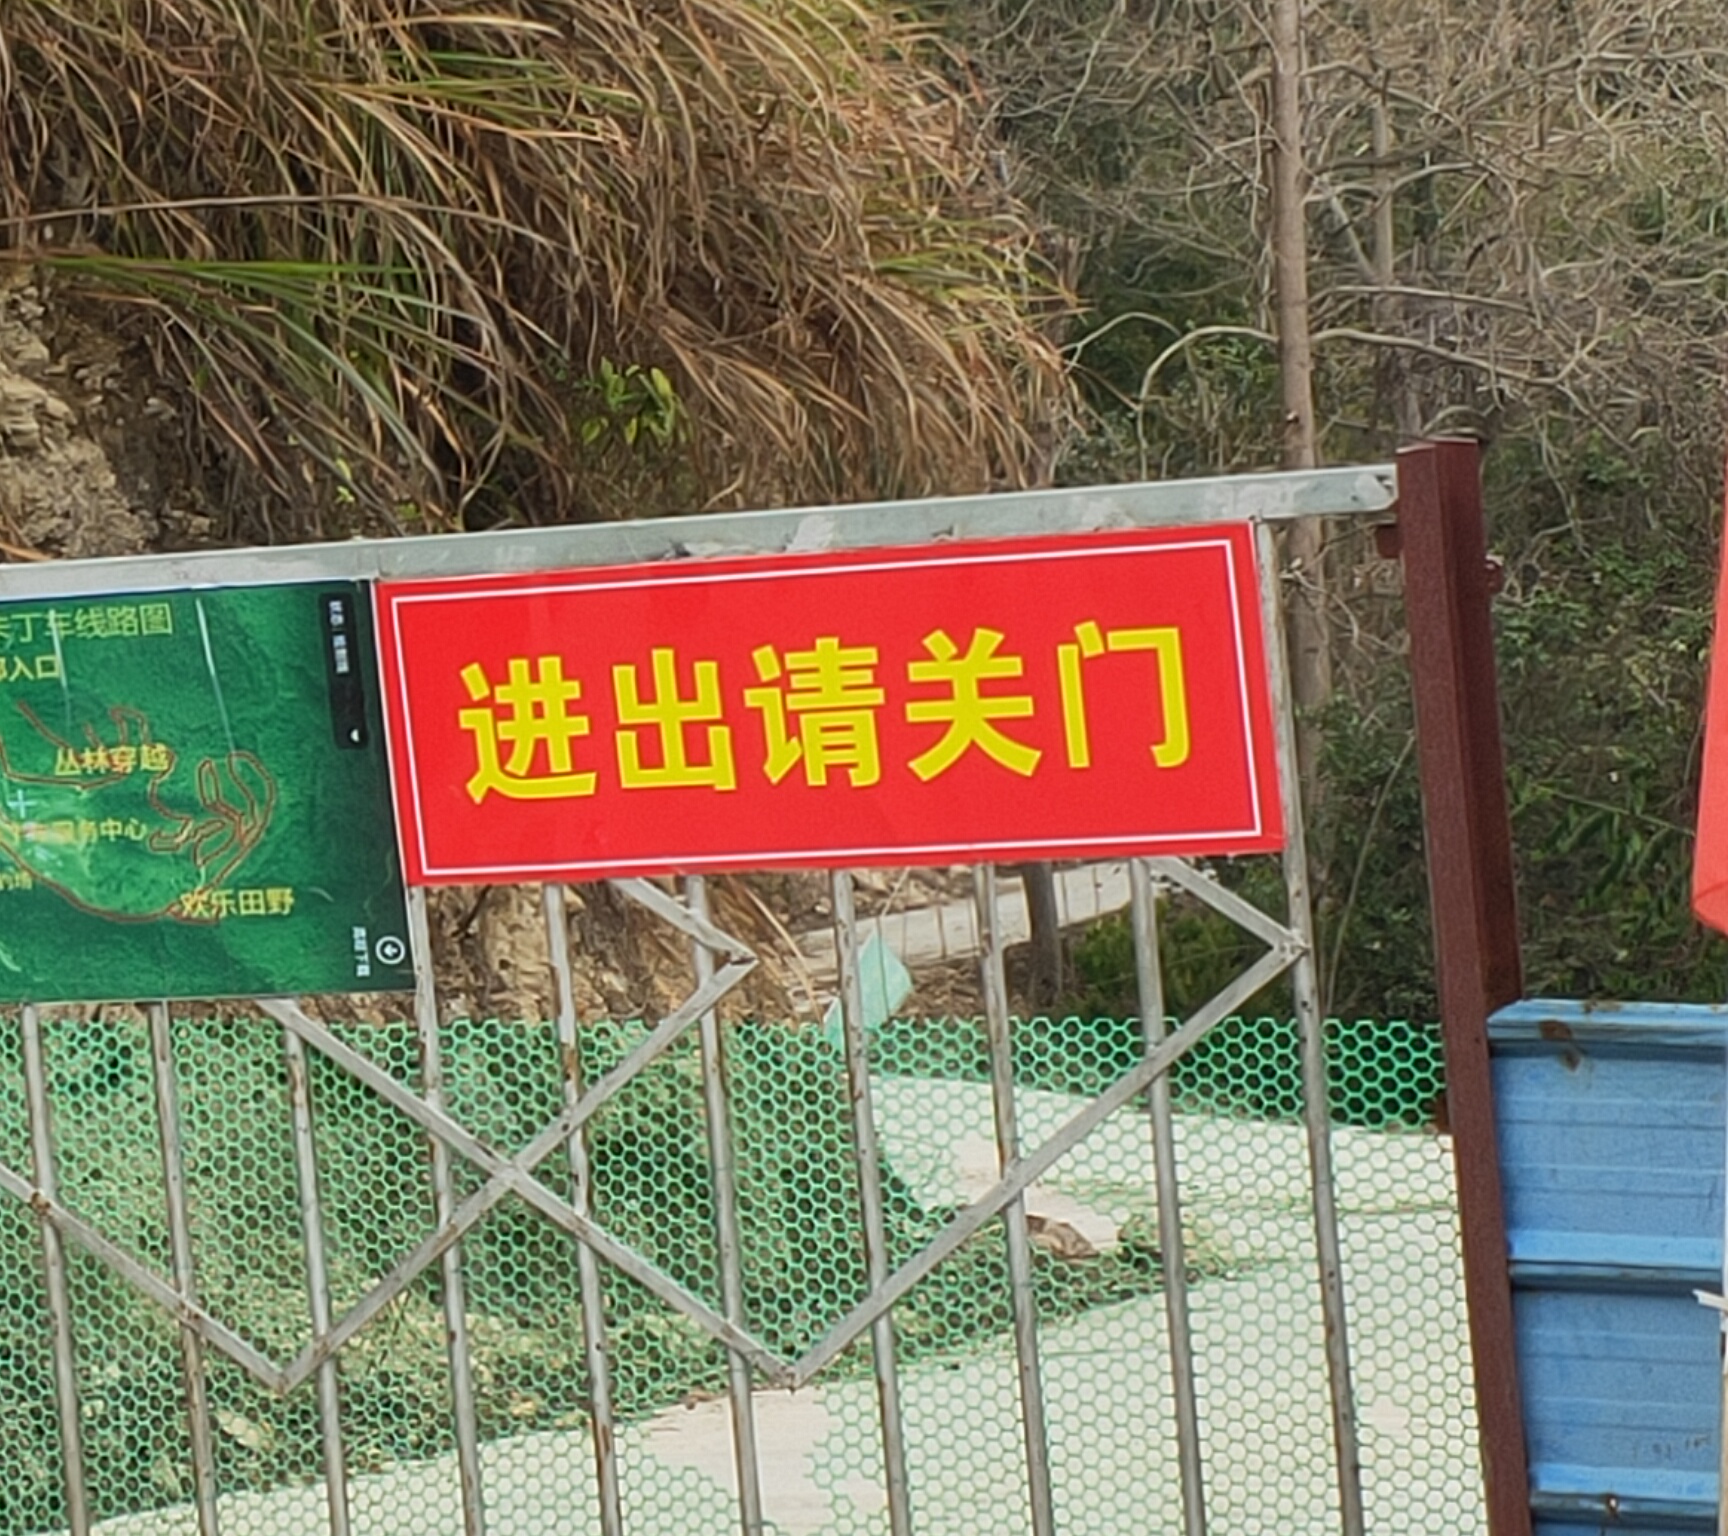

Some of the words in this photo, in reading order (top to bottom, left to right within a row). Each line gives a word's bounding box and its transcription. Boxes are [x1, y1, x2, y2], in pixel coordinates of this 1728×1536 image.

[457, 619, 1194, 805] 进出请关门
[180, 886, 296, 919] 欢乐田野
